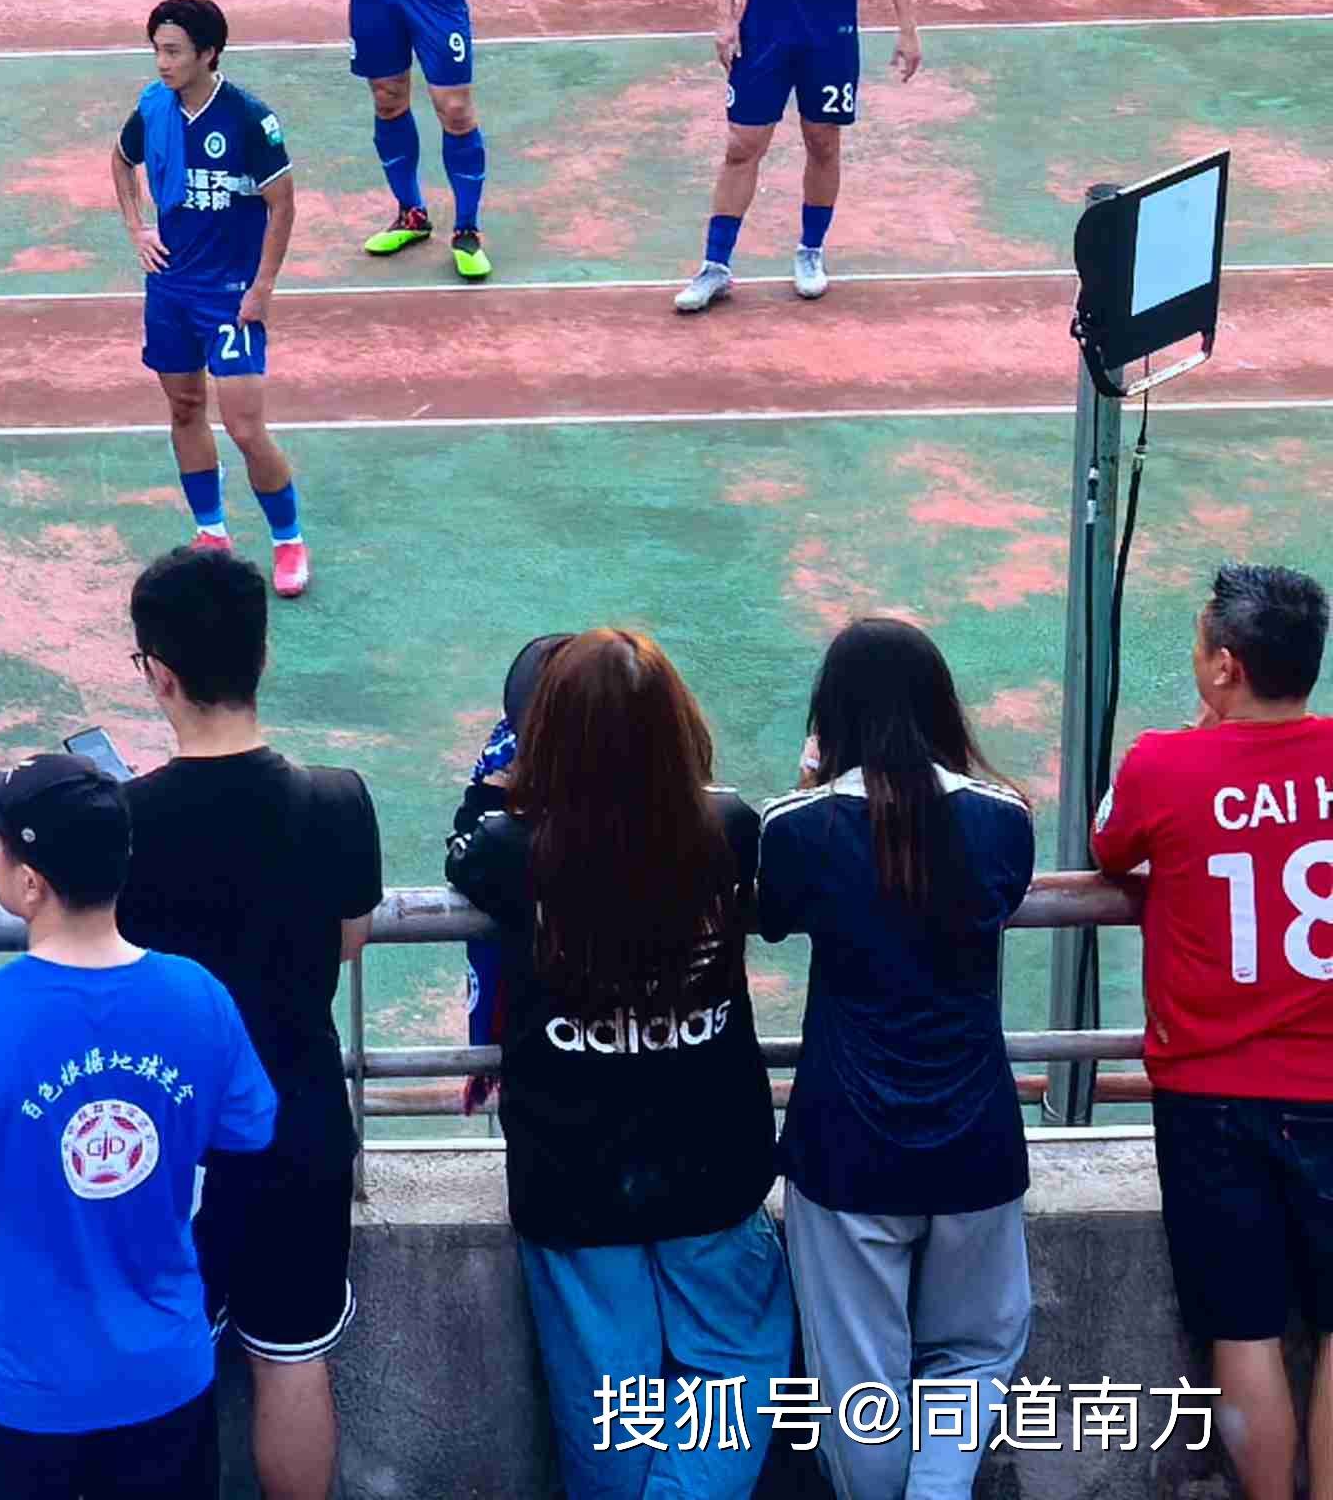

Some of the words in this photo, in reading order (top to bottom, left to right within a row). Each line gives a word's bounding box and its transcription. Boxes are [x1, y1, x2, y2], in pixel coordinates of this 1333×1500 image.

[448, 32, 466, 63] 9
[821, 82, 854, 113] 28
[218, 324, 253, 360] 21
[1213, 779, 1298, 831] CAI
[1207, 839, 1333, 984] 18
[545, 999, 732, 1055] adidas
